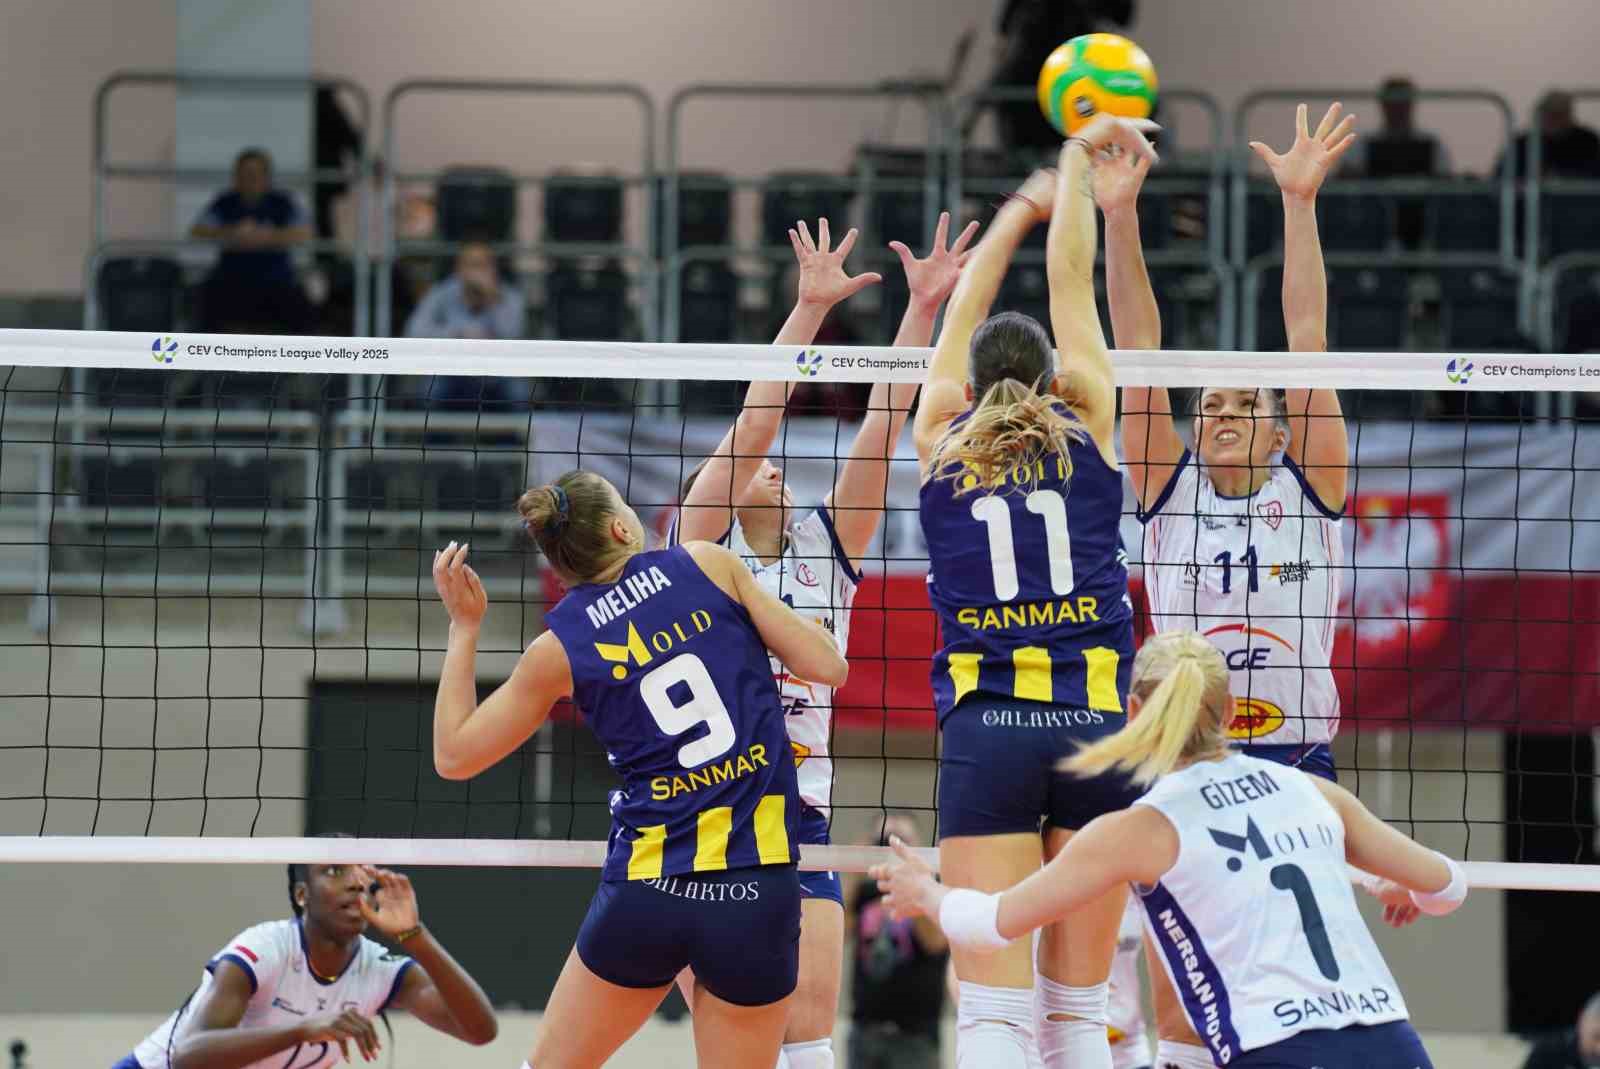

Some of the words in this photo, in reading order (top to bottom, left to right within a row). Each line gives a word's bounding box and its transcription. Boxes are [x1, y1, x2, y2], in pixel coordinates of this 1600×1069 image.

[187, 344, 212, 356] CEV
[214, 345, 278, 359] Champions
[280, 347, 322, 360] League
[324, 348, 360, 360] Volley
[361, 348, 389, 359] 2025
[831, 357, 856, 368] CEV
[857, 357, 920, 371] Champions
[1483, 365, 1508, 376] CEV
[1510, 366, 1576, 378] Champions
[1579, 366, 1600, 377] Lea
[971, 489, 1075, 601] 11
[1213, 545, 1259, 594] 11
[585, 566, 673, 630] MELIHA
[957, 596, 1101, 631] SANMAR
[1221, 647, 1271, 671] GE
[639, 652, 736, 769] 9
[650, 743, 770, 801] SANMAR
[1270, 863, 1340, 983] 1
[1157, 908, 1216, 1005] NERSAN
